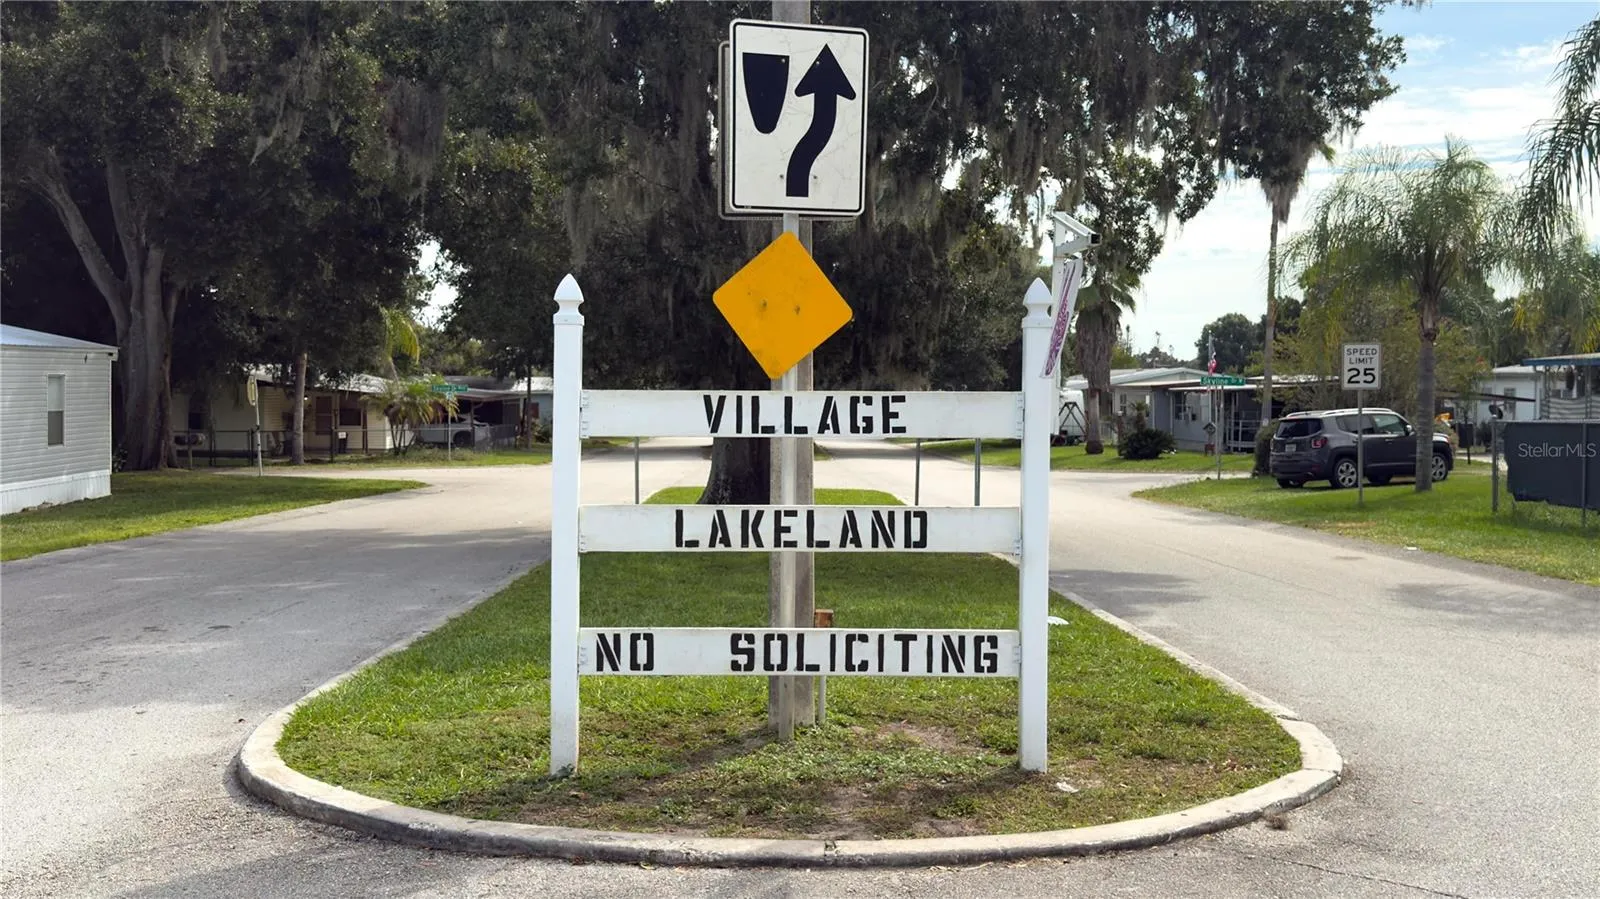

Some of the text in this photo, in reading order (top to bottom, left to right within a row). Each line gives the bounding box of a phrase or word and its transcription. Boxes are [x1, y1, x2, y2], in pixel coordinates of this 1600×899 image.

[1346, 348, 1377, 356] SPEED
[1203, 376, 1228, 385] Skyline
[1347, 367, 1376, 384] 25
[703, 394, 907, 435] VILLAGE
[674, 509, 928, 549] LAKELAND
[596, 632, 999, 674] NO SOLICITING
